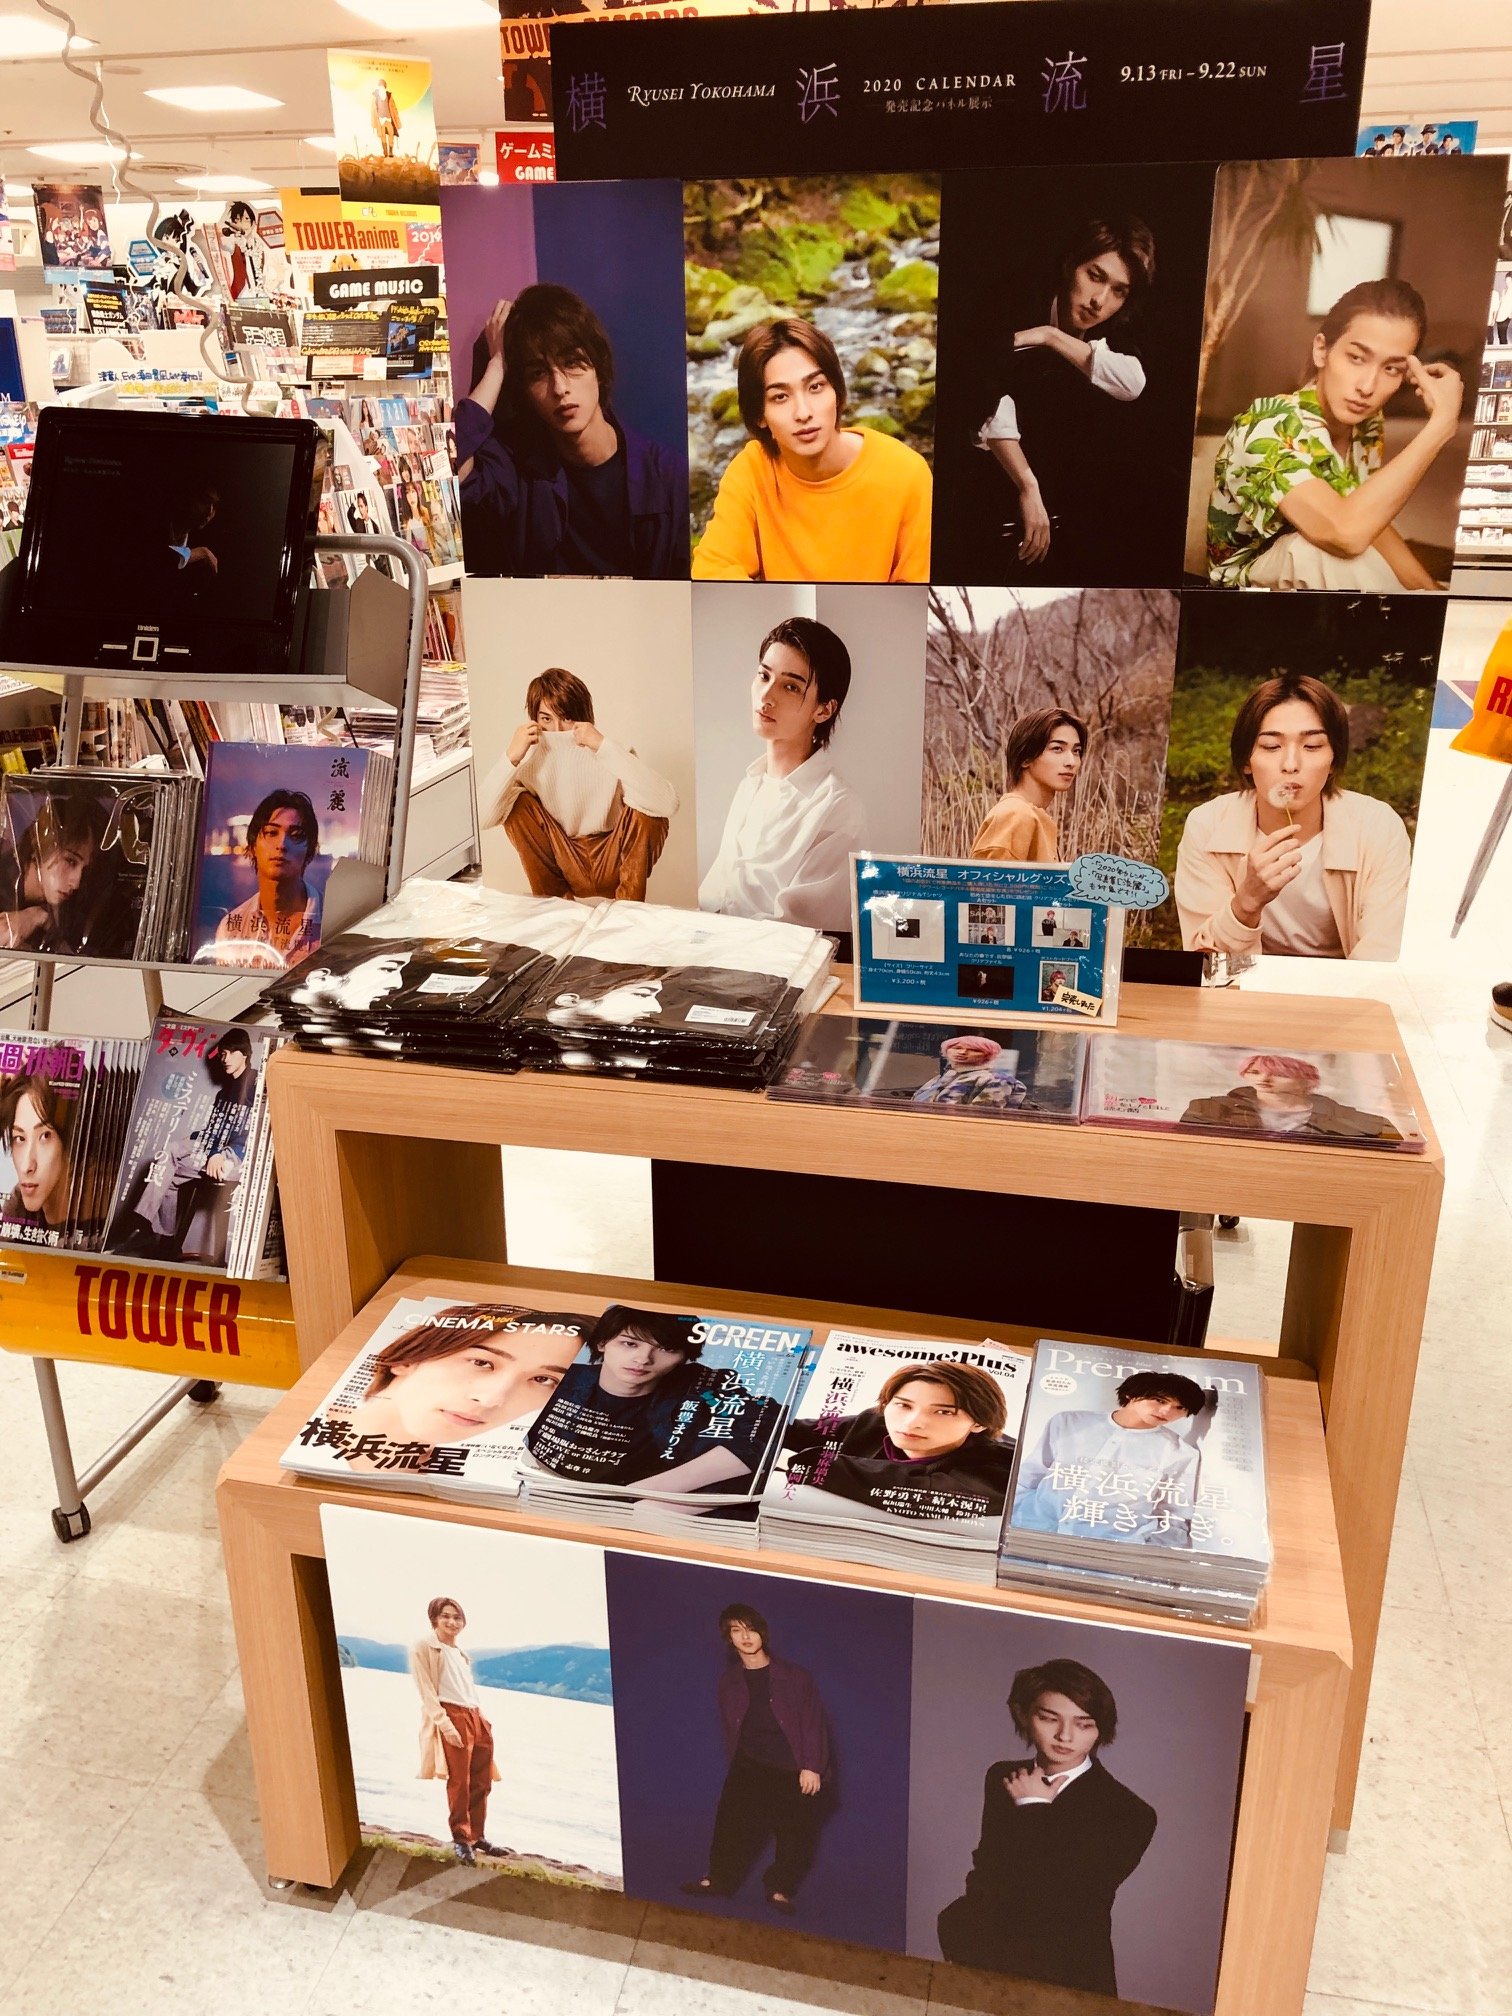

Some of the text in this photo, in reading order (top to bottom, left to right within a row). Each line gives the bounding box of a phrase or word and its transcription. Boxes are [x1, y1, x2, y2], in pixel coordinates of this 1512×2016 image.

[690, 82, 776, 100] YOKOHAMA
[797, 63, 841, 123] 浜
[863, 74, 1016, 93] 2020 CALENDAR
[1041, 51, 1088, 113] 流
[1120, 65, 1156, 82] 9.13
[1159, 70, 1182, 80] FRI
[1199, 62, 1236, 80] 9.22
[1239, 66, 1267, 78] SUN
[1303, 42, 1349, 101] 星
[565, 72, 607, 132] 横
[515, 165, 554, 181] GAME
[329, 279, 424, 299] GAME MUSIC
[327, 757, 350, 812] 流麗
[896, 865, 949, 881] 横浜流星
[225, 913, 315, 937] 横浜流星
[74, 1264, 242, 1357] TOWER
[405, 1313, 582, 1338] CINEMA STARS
[686, 1321, 800, 1353] SCREEN
[697, 1350, 766, 1440] 横浜流星
[989, 1368, 1015, 1379] Vol.04
[660, 1399, 701, 1461] 飯豊まりえ
[812, 1376, 856, 1438] 横浜流星
[300, 1417, 471, 1477] 横浜流星
[1058, 1494, 1234, 1546] 輝きすぎ。
